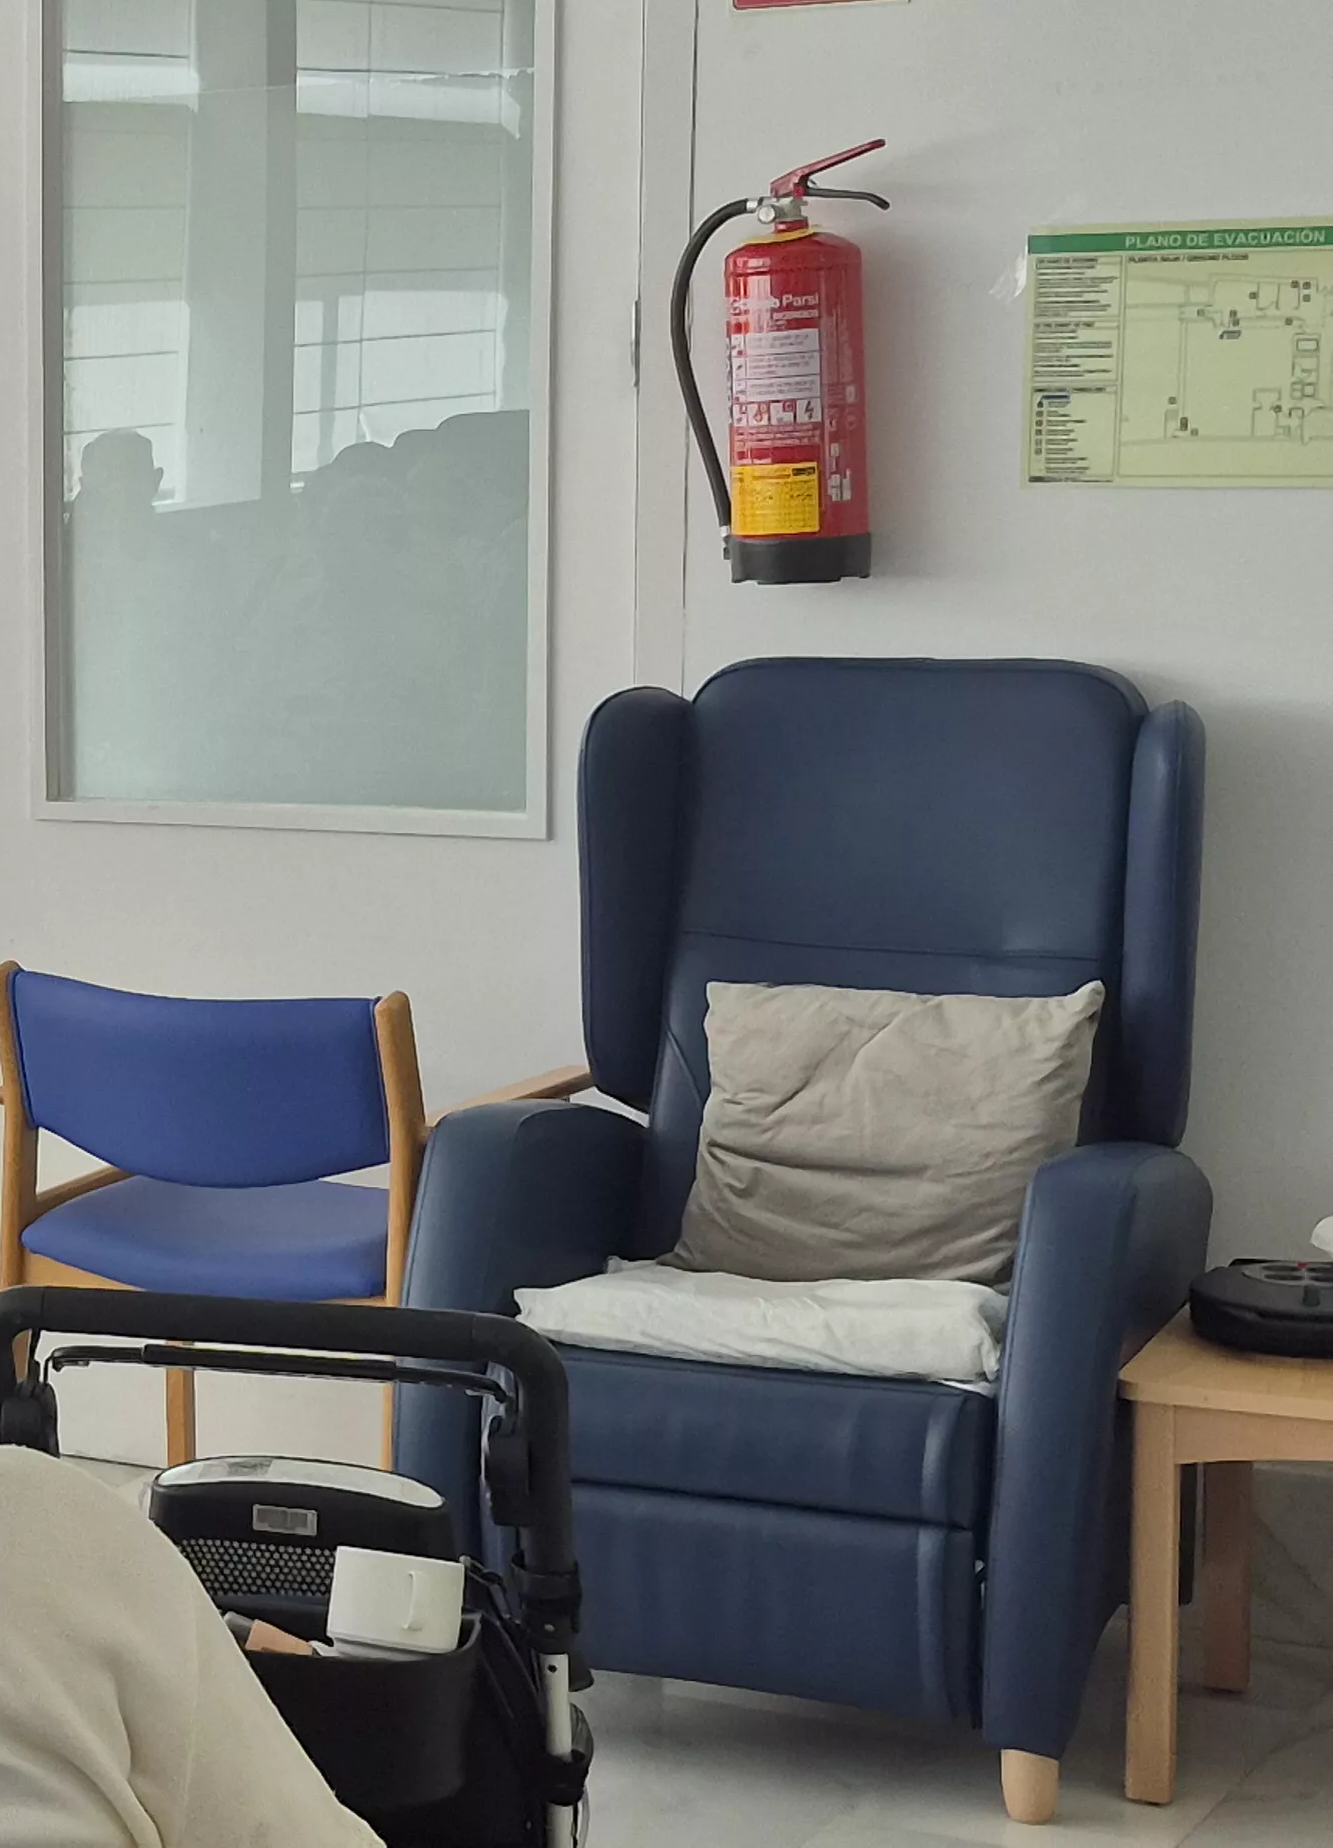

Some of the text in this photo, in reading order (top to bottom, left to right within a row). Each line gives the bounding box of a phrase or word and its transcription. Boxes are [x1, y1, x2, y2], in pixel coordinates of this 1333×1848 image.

[1124, 229, 1327, 249] PLANO DE EVACUACIÓN
